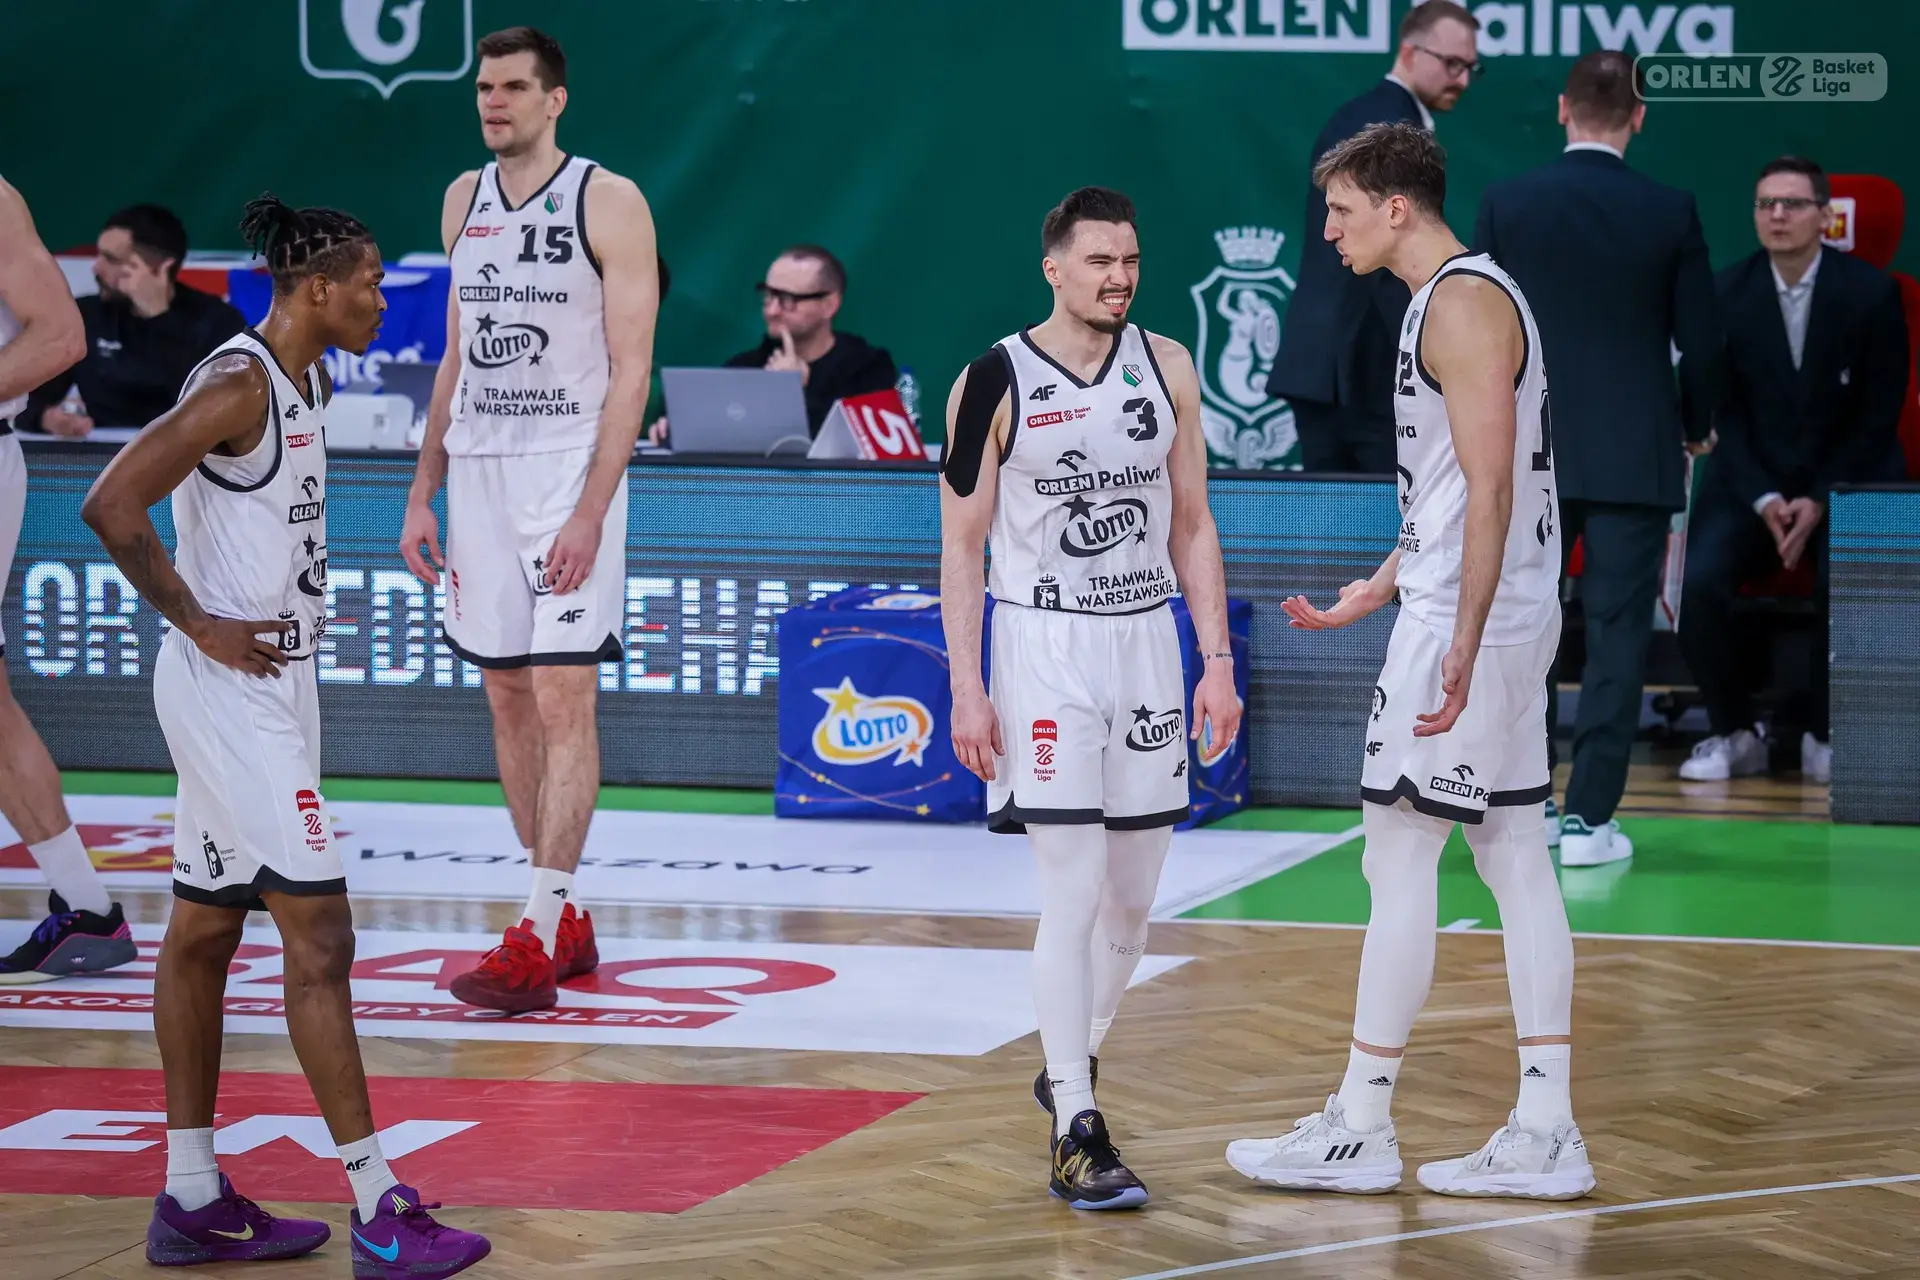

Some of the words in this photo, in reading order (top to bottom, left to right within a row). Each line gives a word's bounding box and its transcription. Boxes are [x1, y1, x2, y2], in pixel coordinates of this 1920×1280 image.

[1140, 0, 1371, 37] ORLEN
[1472, 0, 1734, 57] aliwa
[518, 224, 573, 264] 15
[461, 288, 498, 300] ORLEN
[504, 285, 568, 303] Paliwa
[481, 333, 531, 360] LOTTO
[484, 388, 566, 401] TRAMWAJE
[1029, 384, 1057, 401] 4F
[474, 402, 580, 416] WARSZAWSKIE
[1030, 414, 1060, 426] ORLEN
[1122, 397, 1158, 441] 3
[1037, 475, 1092, 494] ORLEN
[1077, 508, 1135, 546] LOTTO
[1089, 565, 1165, 591] TRAMWAJE
[1076, 579, 1174, 609] WARSZAWSKIE
[557, 608, 586, 624] 4F
[840, 714, 908, 747] LOTTO
[1141, 716, 1180, 744] LOTTO
[1366, 741, 1383, 756] 4F
[1432, 778, 1471, 796] ORLEN
[311, 845, 325, 853] Liga
[361, 849, 872, 874] Wazawa
[464, 1010, 689, 1024] ORLEN
